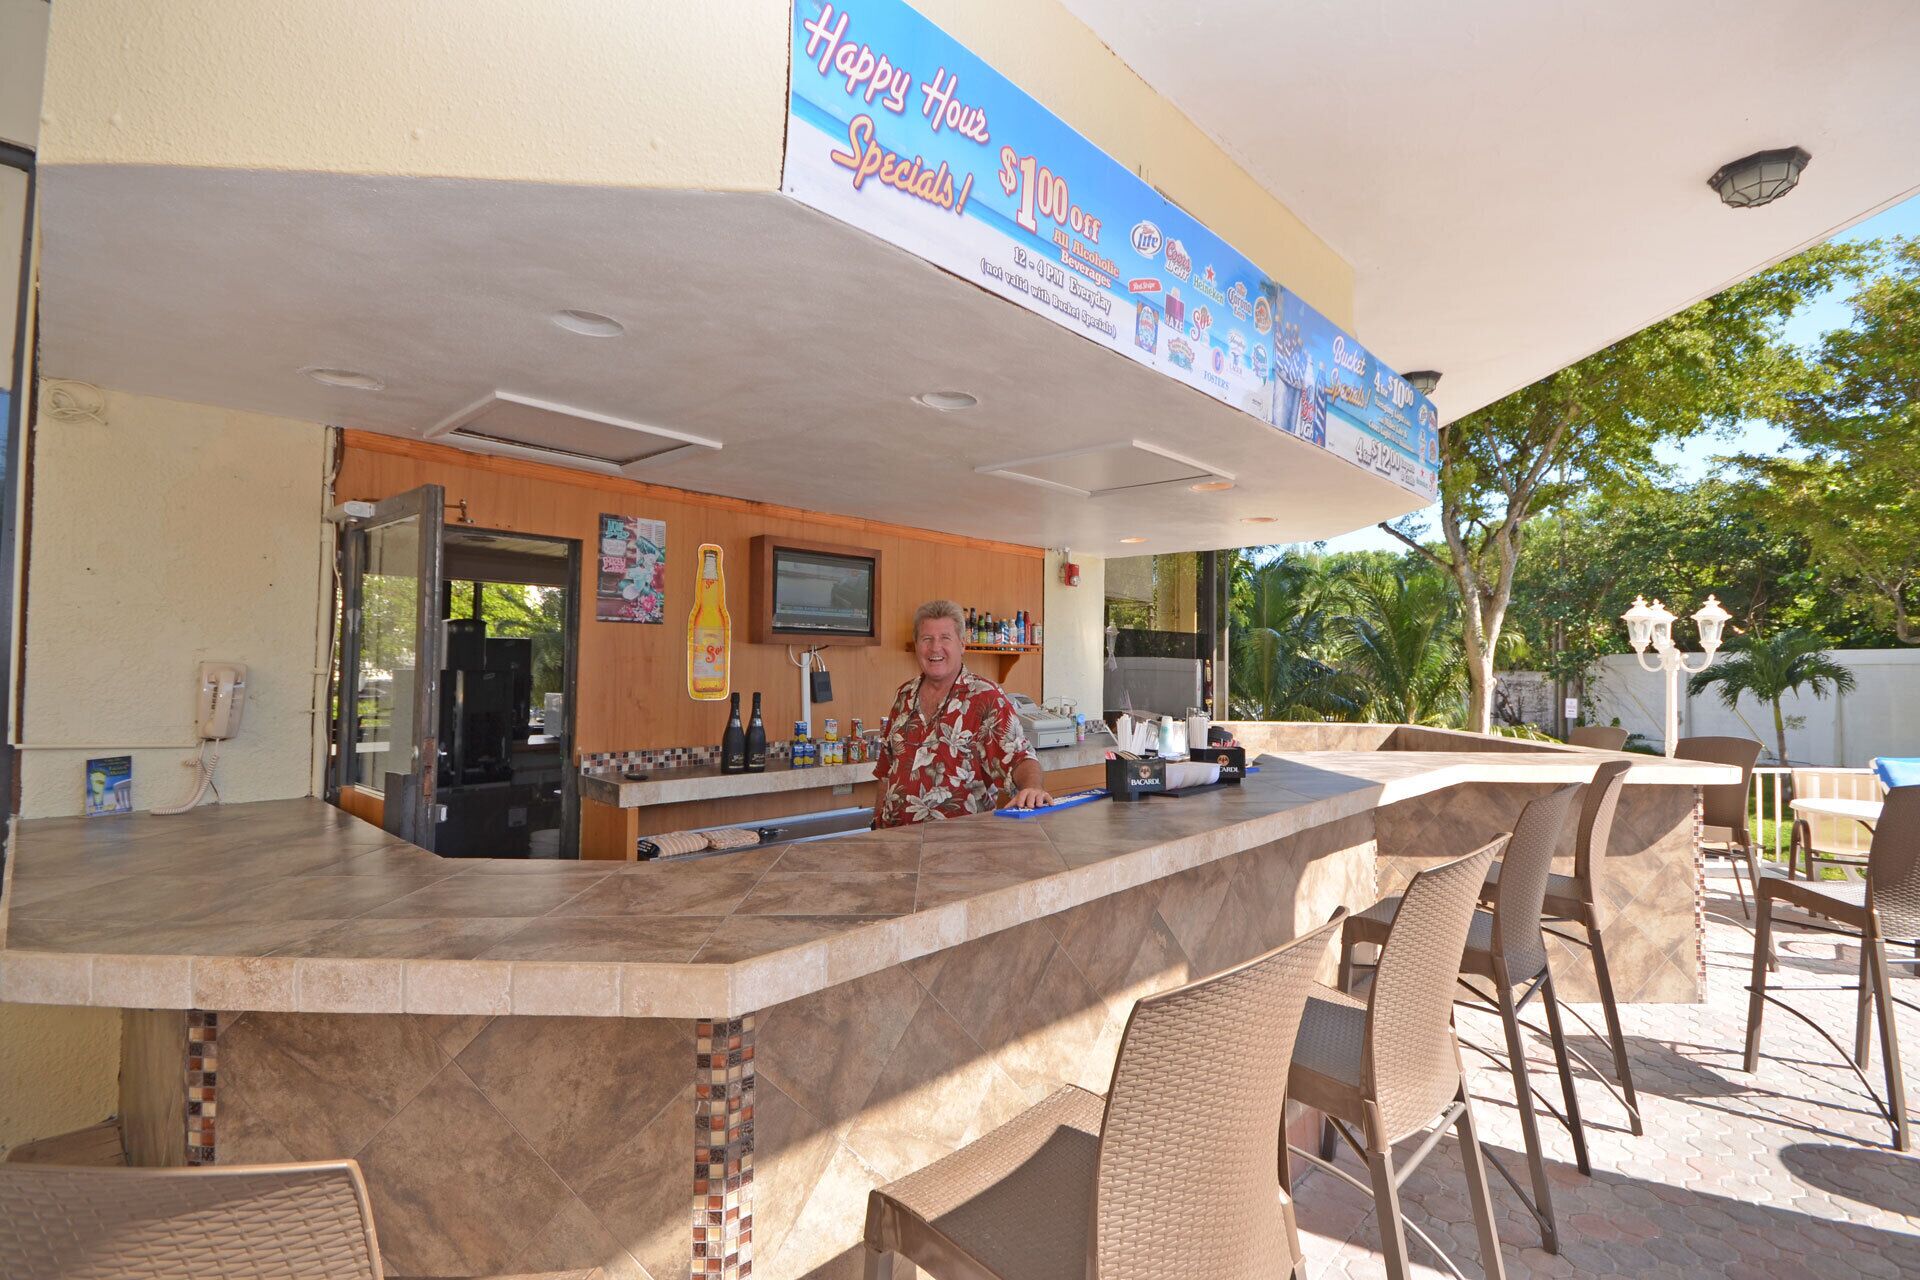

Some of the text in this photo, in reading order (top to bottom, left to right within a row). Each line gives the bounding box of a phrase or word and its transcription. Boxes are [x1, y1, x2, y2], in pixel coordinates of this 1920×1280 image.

[804, 3, 991, 143] Happy Hour
[831, 115, 974, 215] Specials!
[1053, 228, 1119, 278] All Alcoholic
[1137, 233, 1158, 250] Lite
[1166, 240, 1191, 272] Coors
[1014, 247, 1026, 268] 12
[1037, 260, 1043, 277] 4
[1046, 264, 1064, 287] PM
[1069, 277, 1111, 316] Everyday
[1061, 248, 1111, 289] Beverages
[1005, 272, 1029, 293] valid
[1031, 285, 1050, 304] with
[1052, 294, 1079, 319] Bucket
[1194, 275, 1224, 305] Heineken
[1228, 288, 1252, 315] Corona
[1333, 335, 1366, 376] Bucket
[1374, 371, 1380, 393] 4
[1356, 437, 1363, 462] 4
